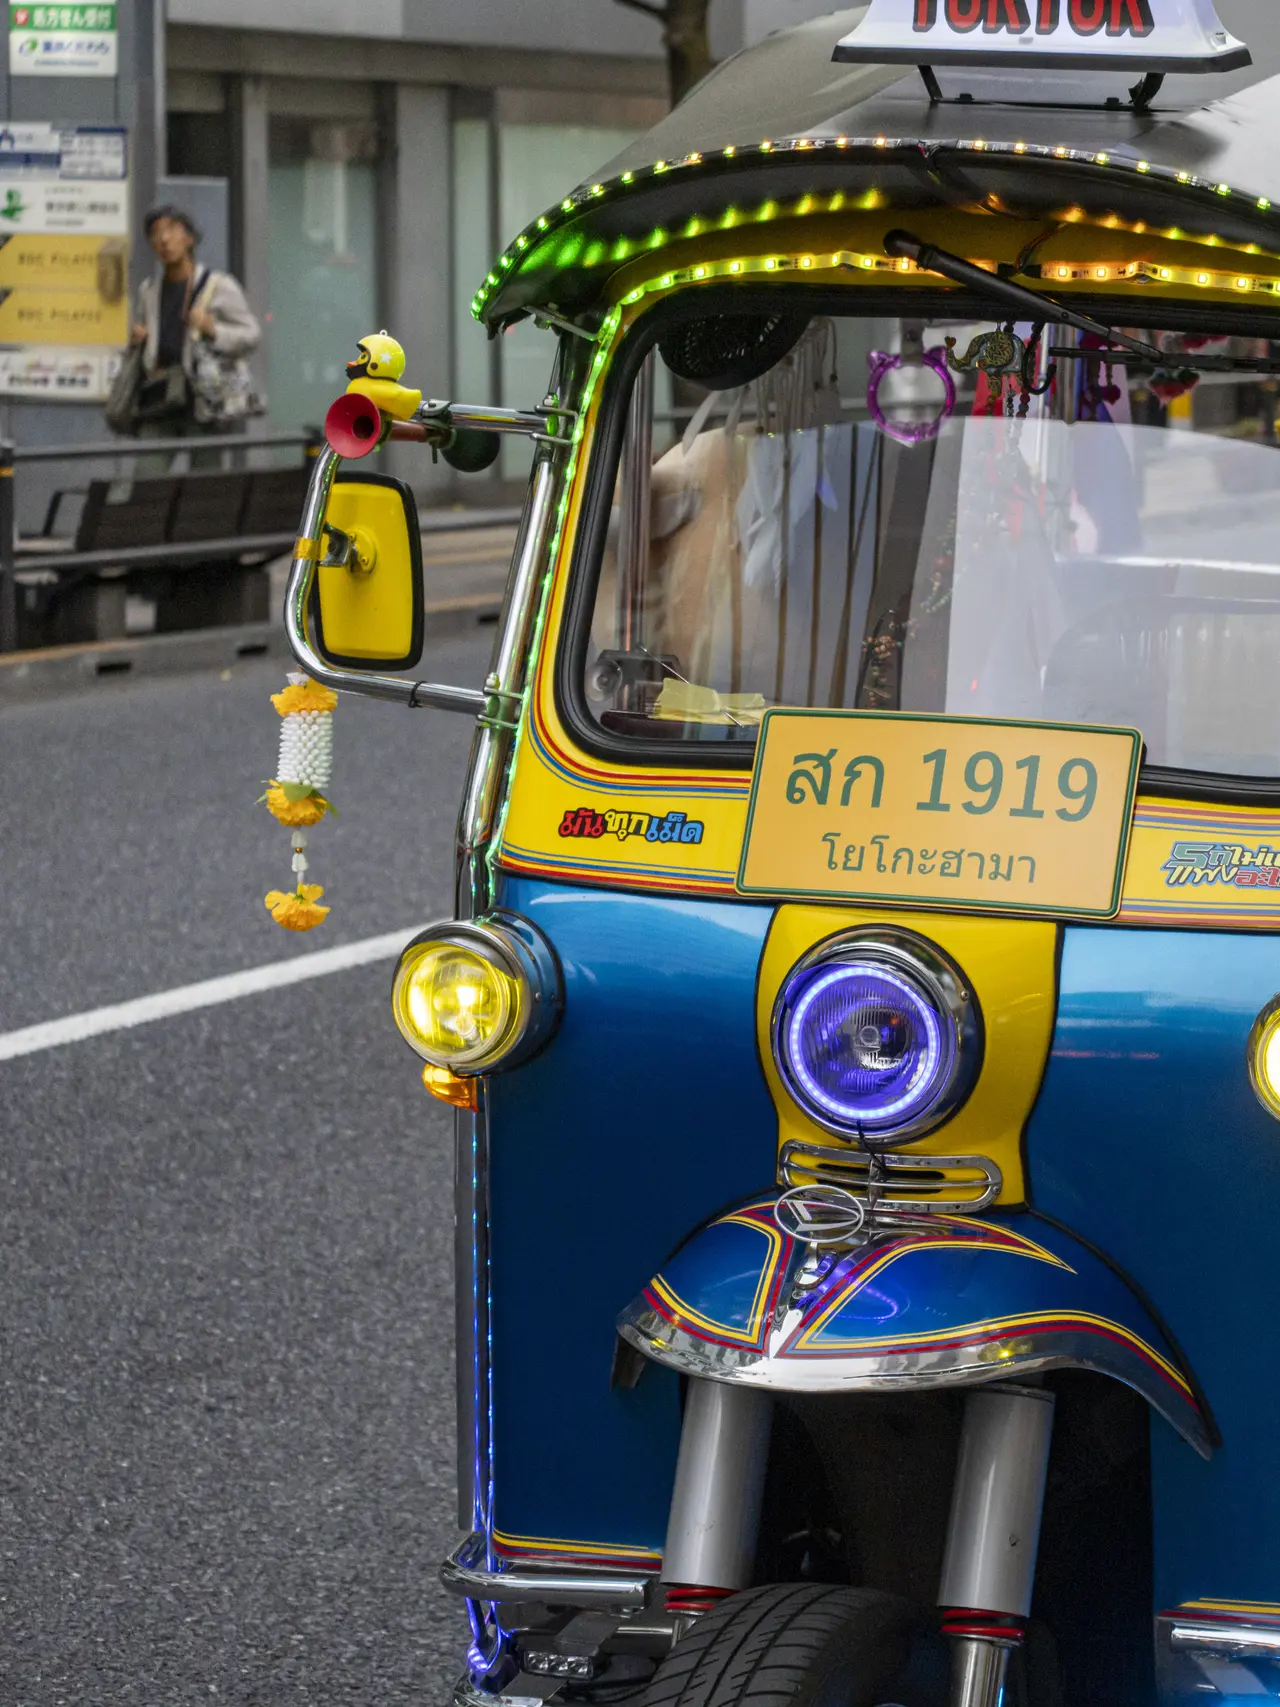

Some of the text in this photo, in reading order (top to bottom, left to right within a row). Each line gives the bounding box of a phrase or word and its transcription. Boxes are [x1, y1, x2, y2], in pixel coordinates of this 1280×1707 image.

[785, 748, 1099, 822] สก 1919
[821, 832, 1037, 883] โยโกะฮามา
